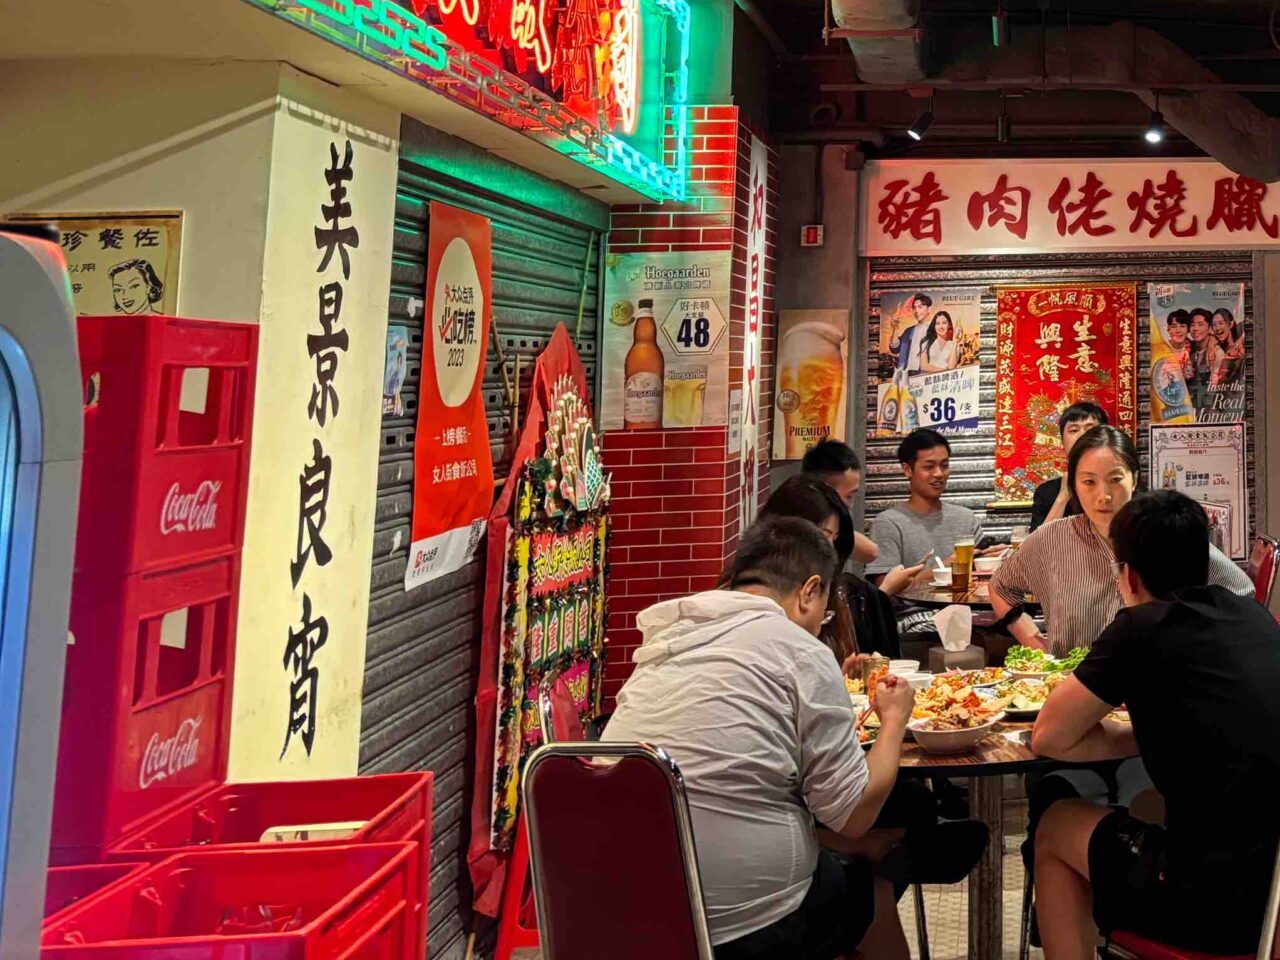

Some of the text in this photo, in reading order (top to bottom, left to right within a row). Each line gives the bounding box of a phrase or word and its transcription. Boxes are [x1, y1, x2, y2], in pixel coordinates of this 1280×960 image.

[878, 169, 1280, 245] 豬肉佬燒臘
[645, 264, 711, 281] Hoegaarden
[1037, 291, 1094, 310] 一帆風順
[677, 318, 710, 348] 48
[1035, 322, 1069, 383] 興隆
[1068, 315, 1099, 373] 生意
[447, 348, 465, 368] 2023
[1230, 380, 1245, 391] the
[1212, 393, 1245, 410] Real
[789, 426, 831, 437] PREMIUM
[278, 140, 360, 762] 美景良宵
